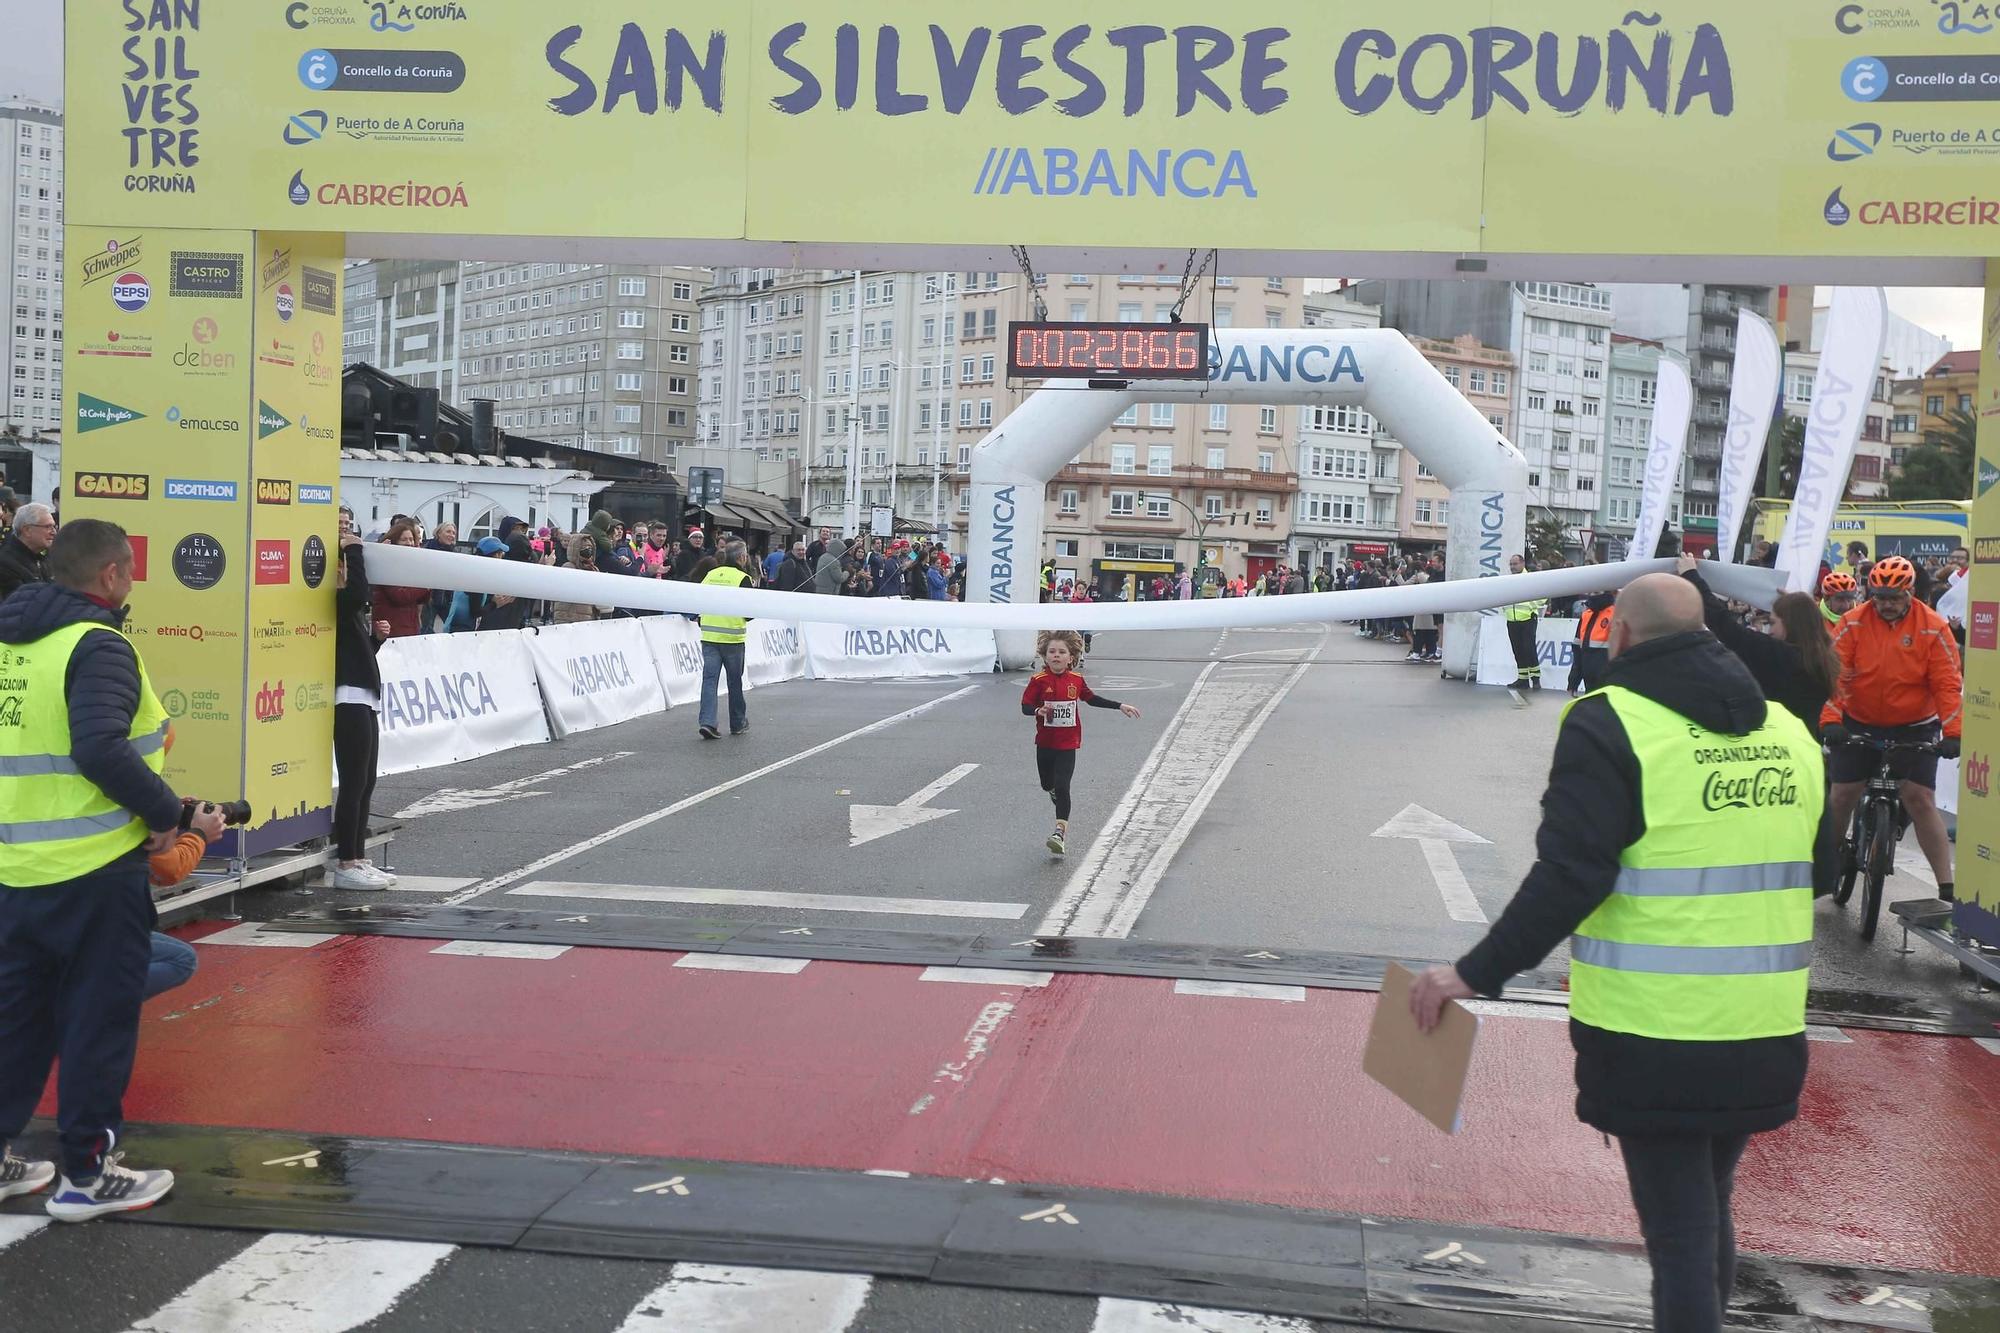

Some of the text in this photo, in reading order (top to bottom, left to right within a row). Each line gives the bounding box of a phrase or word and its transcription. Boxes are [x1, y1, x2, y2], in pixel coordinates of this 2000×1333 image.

[123, 0, 199, 32] SAN
[123, 35, 199, 81] SIL
[343, 65, 453, 78] Concello da Coruña
[545, 11, 1734, 120] SAN SILVESTRE CORUÑA
[1895, 72, 1955, 85] Concello
[1958, 72, 1976, 84] da
[122, 83, 199, 125] VES
[336, 117, 465, 131] Puerto de A Coruña
[1892, 129, 1946, 143] Puerto
[1950, 129, 1971, 142] de
[1975, 130, 1987, 142] A
[121, 127, 199, 168] TRE
[124, 173, 195, 193] CORUÑA
[83, 244, 140, 283] Schweppes
[183, 266, 230, 278] CASTRO
[113, 286, 149, 298] PEPSI
[307, 281, 330, 295] CASTRO
[276, 296, 294, 309] PEPSI
[173, 342, 235, 368] deben
[180, 419, 239, 431] emalcsa
[79, 475, 147, 495] GADIS
[168, 483, 234, 497] DECATHLON
[258, 482, 290, 500] GADIS
[300, 488, 331, 501] DECATHLON
[194, 538, 207, 547] EL
[181, 548, 219, 557] PINAR
[157, 626, 187, 637] etnia
[205, 630, 238, 638] BARCELONA
[192, 690, 220, 701] cada
[192, 702, 213, 711] lata
[192, 711, 229, 721] cuenta
[1694, 743, 1791, 764] ORGANIZACIÓN
